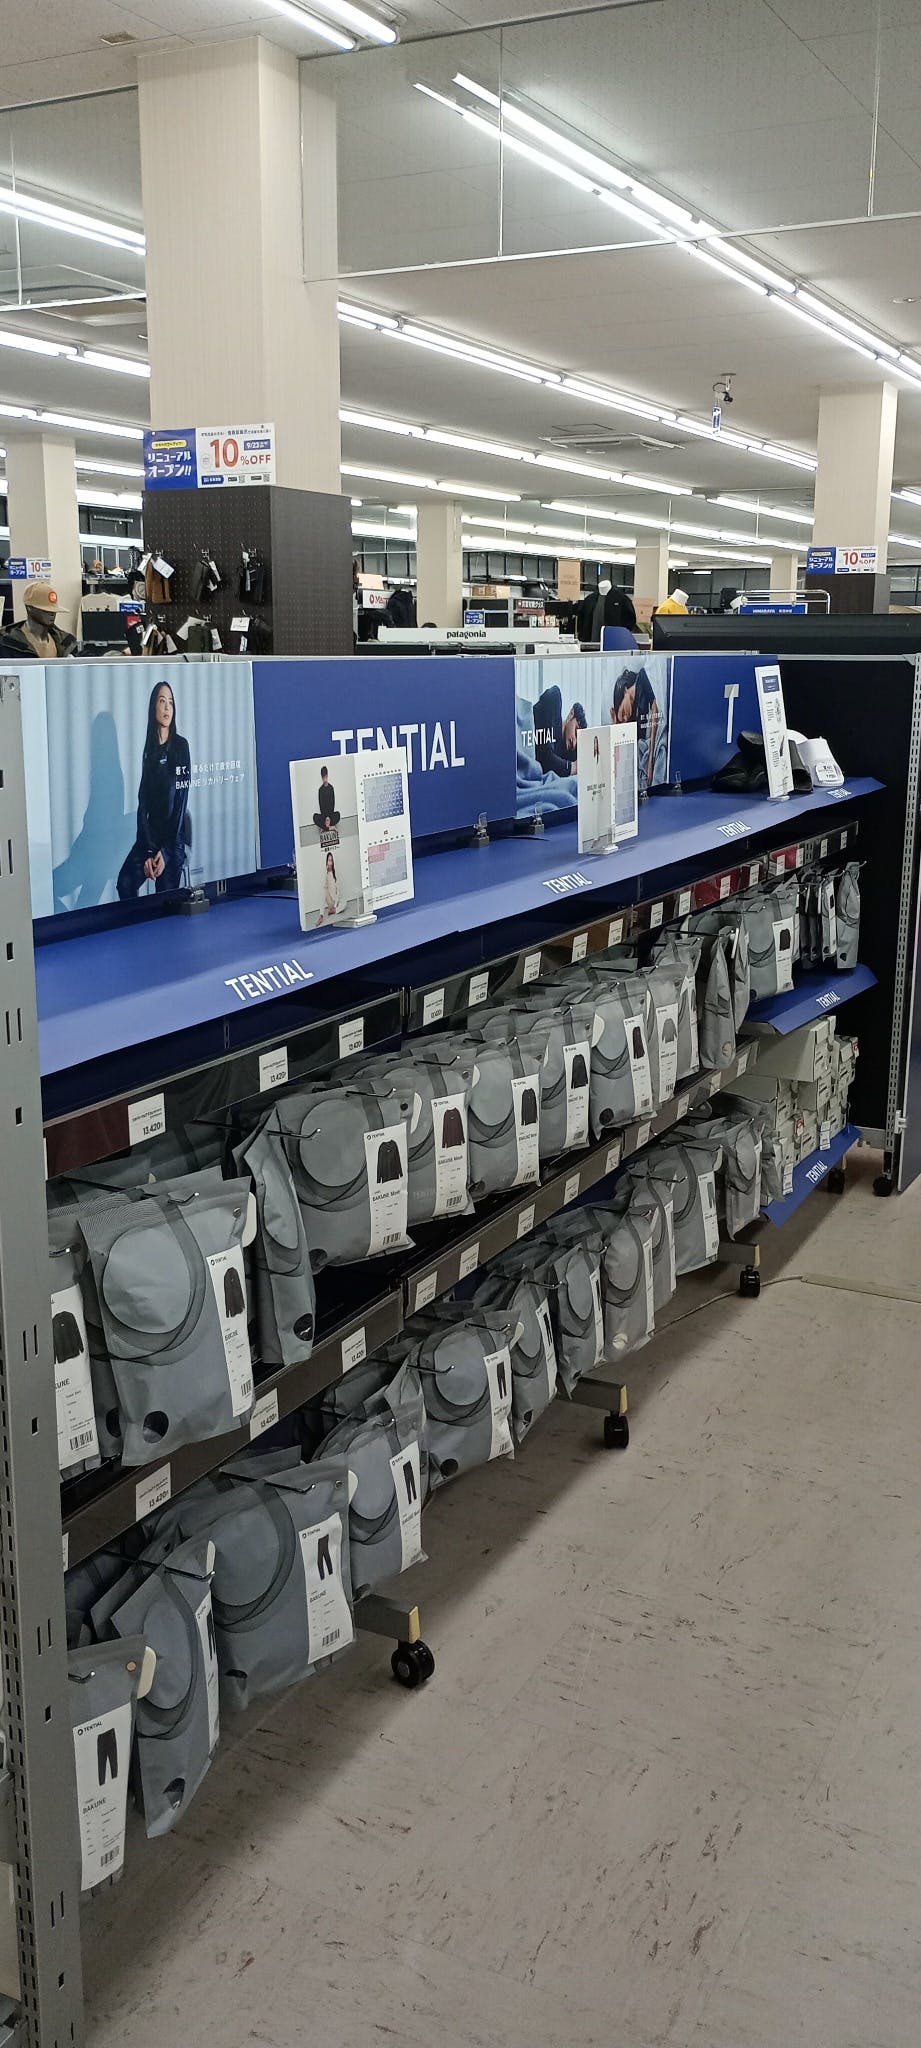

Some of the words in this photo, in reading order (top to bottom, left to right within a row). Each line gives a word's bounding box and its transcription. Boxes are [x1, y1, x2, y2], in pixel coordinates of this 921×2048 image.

[147, 451, 192, 463] リニューアル
[209, 438, 239, 468] 10
[31, 562, 41, 572] 10
[843, 552, 859, 565] 10
[446, 630, 487, 639] patagonia
[521, 726, 557, 747] TENTIAL
[716, 820, 752, 838] TENTIAL
[542, 872, 593, 895] TENTIAL
[223, 959, 314, 1001] TENTIAL
[804, 1160, 829, 1184] TENTIAL
[82, 1797, 107, 1815] BAKUNE
